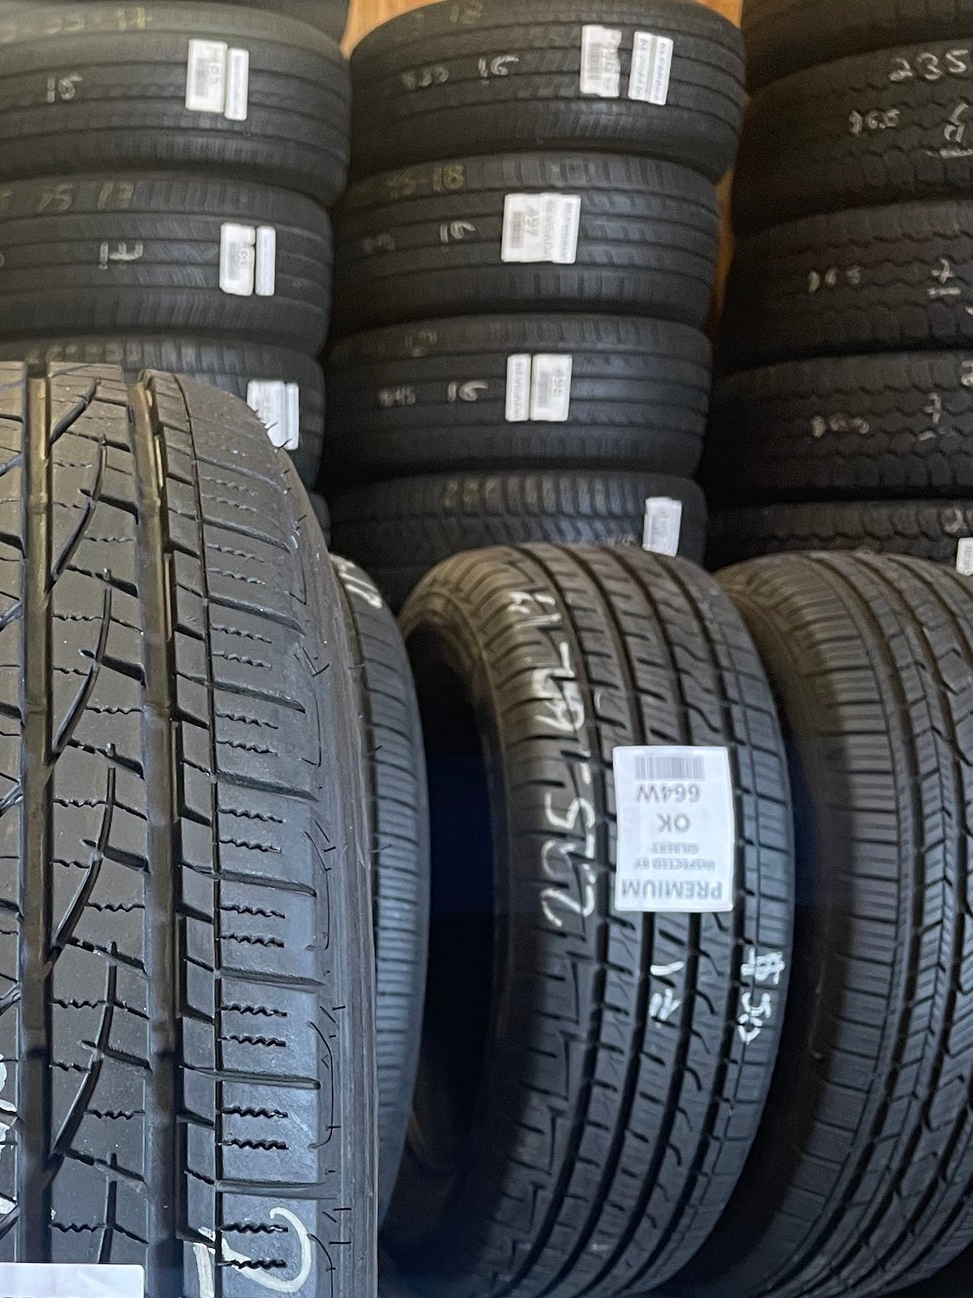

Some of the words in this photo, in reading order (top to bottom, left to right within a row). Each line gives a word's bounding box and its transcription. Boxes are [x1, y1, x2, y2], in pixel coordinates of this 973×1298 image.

[636, 783, 700, 803] 664W
[657, 812, 692, 834] OK
[634, 858, 650, 870] BY
[653, 858, 715, 871] INSPECTED
[621, 879, 723, 901] PREMIUM
